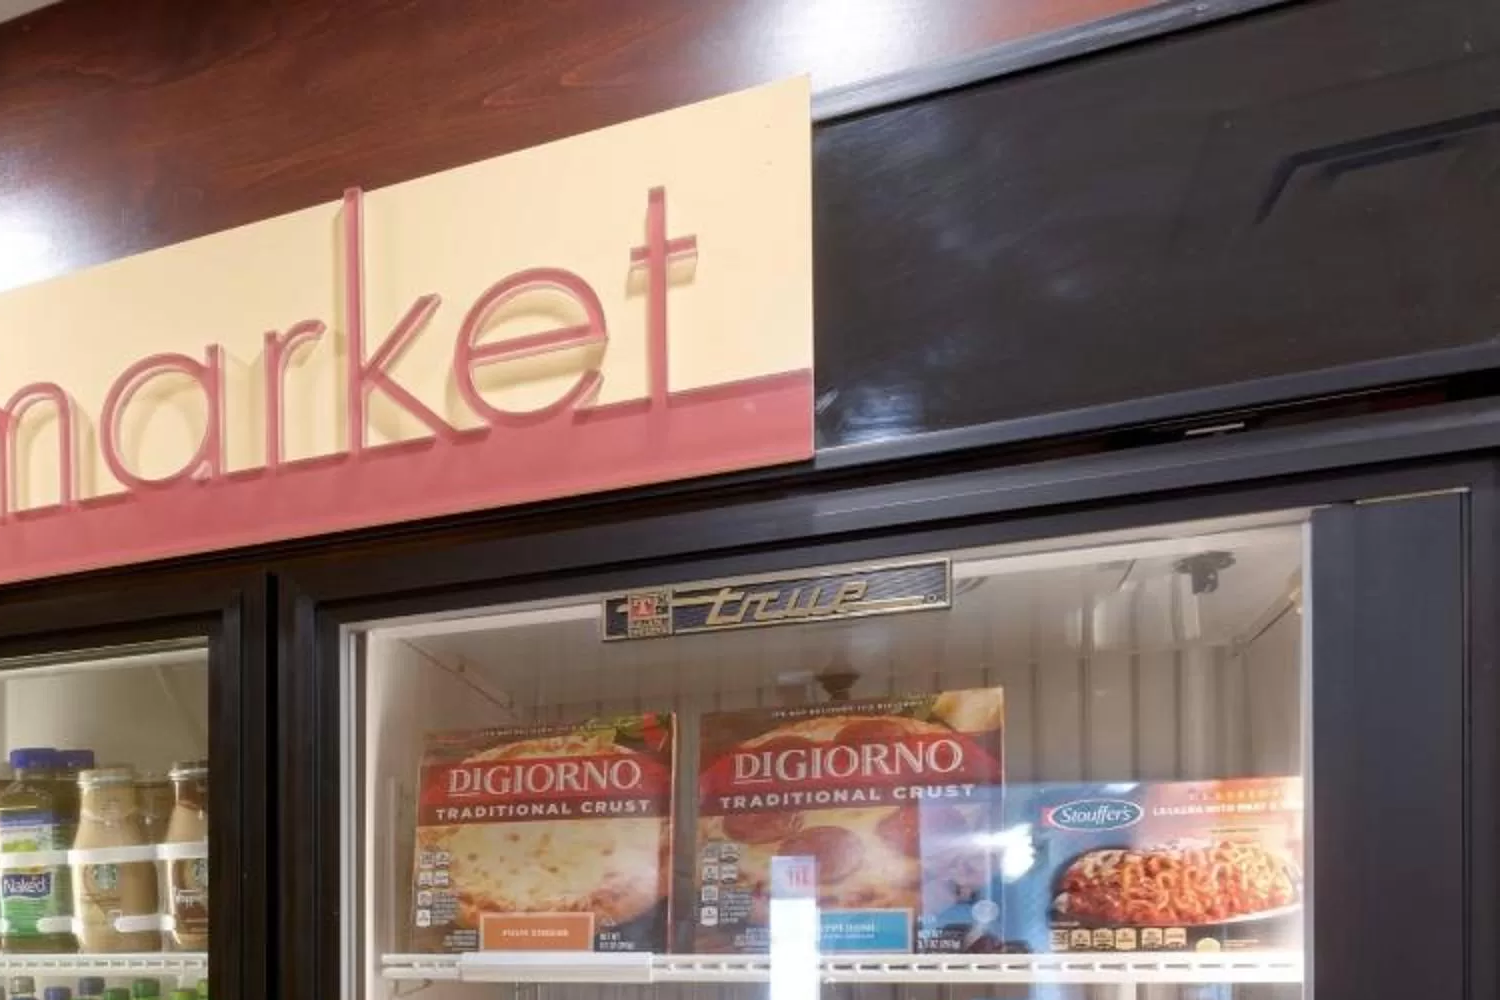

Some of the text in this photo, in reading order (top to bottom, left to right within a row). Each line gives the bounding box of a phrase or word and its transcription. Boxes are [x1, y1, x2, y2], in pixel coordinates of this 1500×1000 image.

[706, 580, 869, 625] true
[720, 783, 976, 810] TRADITIONAL CRUST
[437, 799, 651, 820] TRADITIONAL CRUST
[1060, 805, 1132, 826] Stouffer's
[3, 875, 47, 893] Naked
